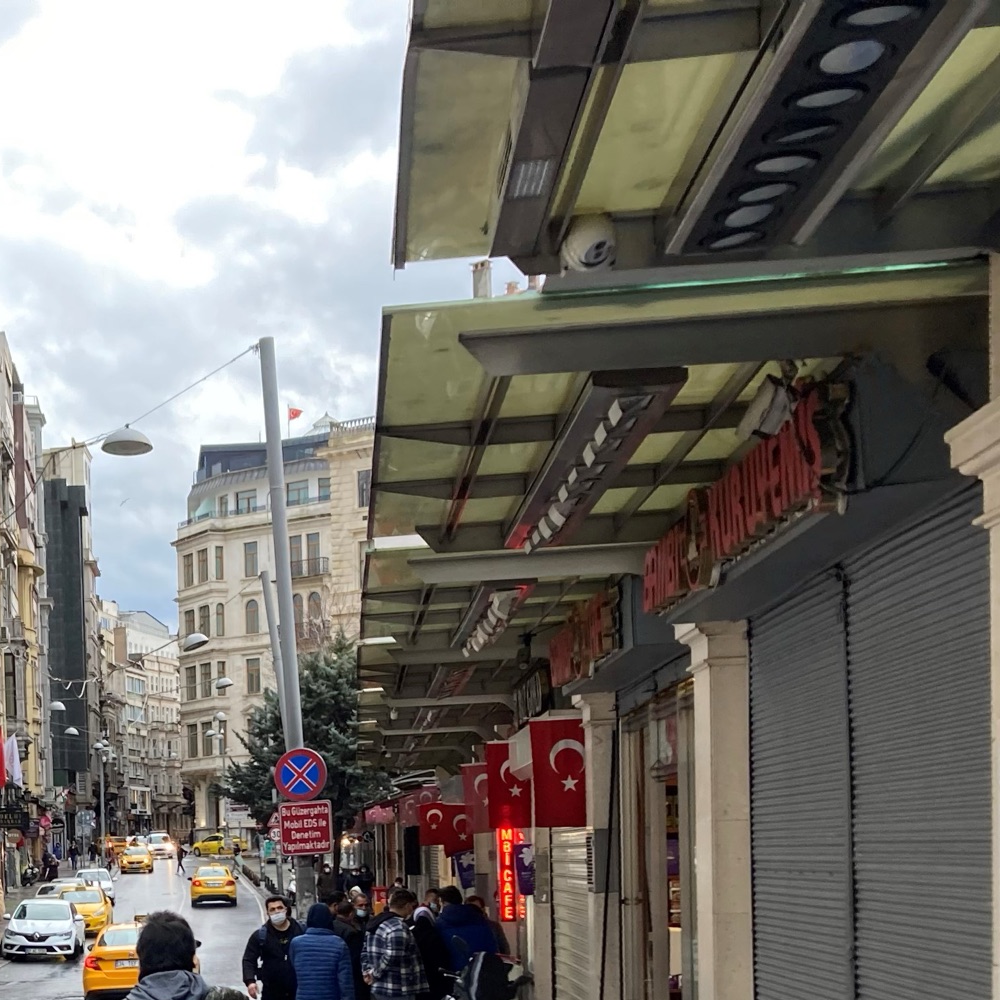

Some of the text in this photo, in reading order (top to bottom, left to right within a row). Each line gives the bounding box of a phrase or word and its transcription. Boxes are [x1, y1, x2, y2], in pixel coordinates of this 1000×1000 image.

[281, 805, 329, 817] Bu Güzergahta
[283, 818, 327, 829] Mobil EDS ile
[291, 830, 321, 840] Denetim
[283, 840, 330, 852] Yapılmaktadır
[503, 869, 514, 919] CAFE
